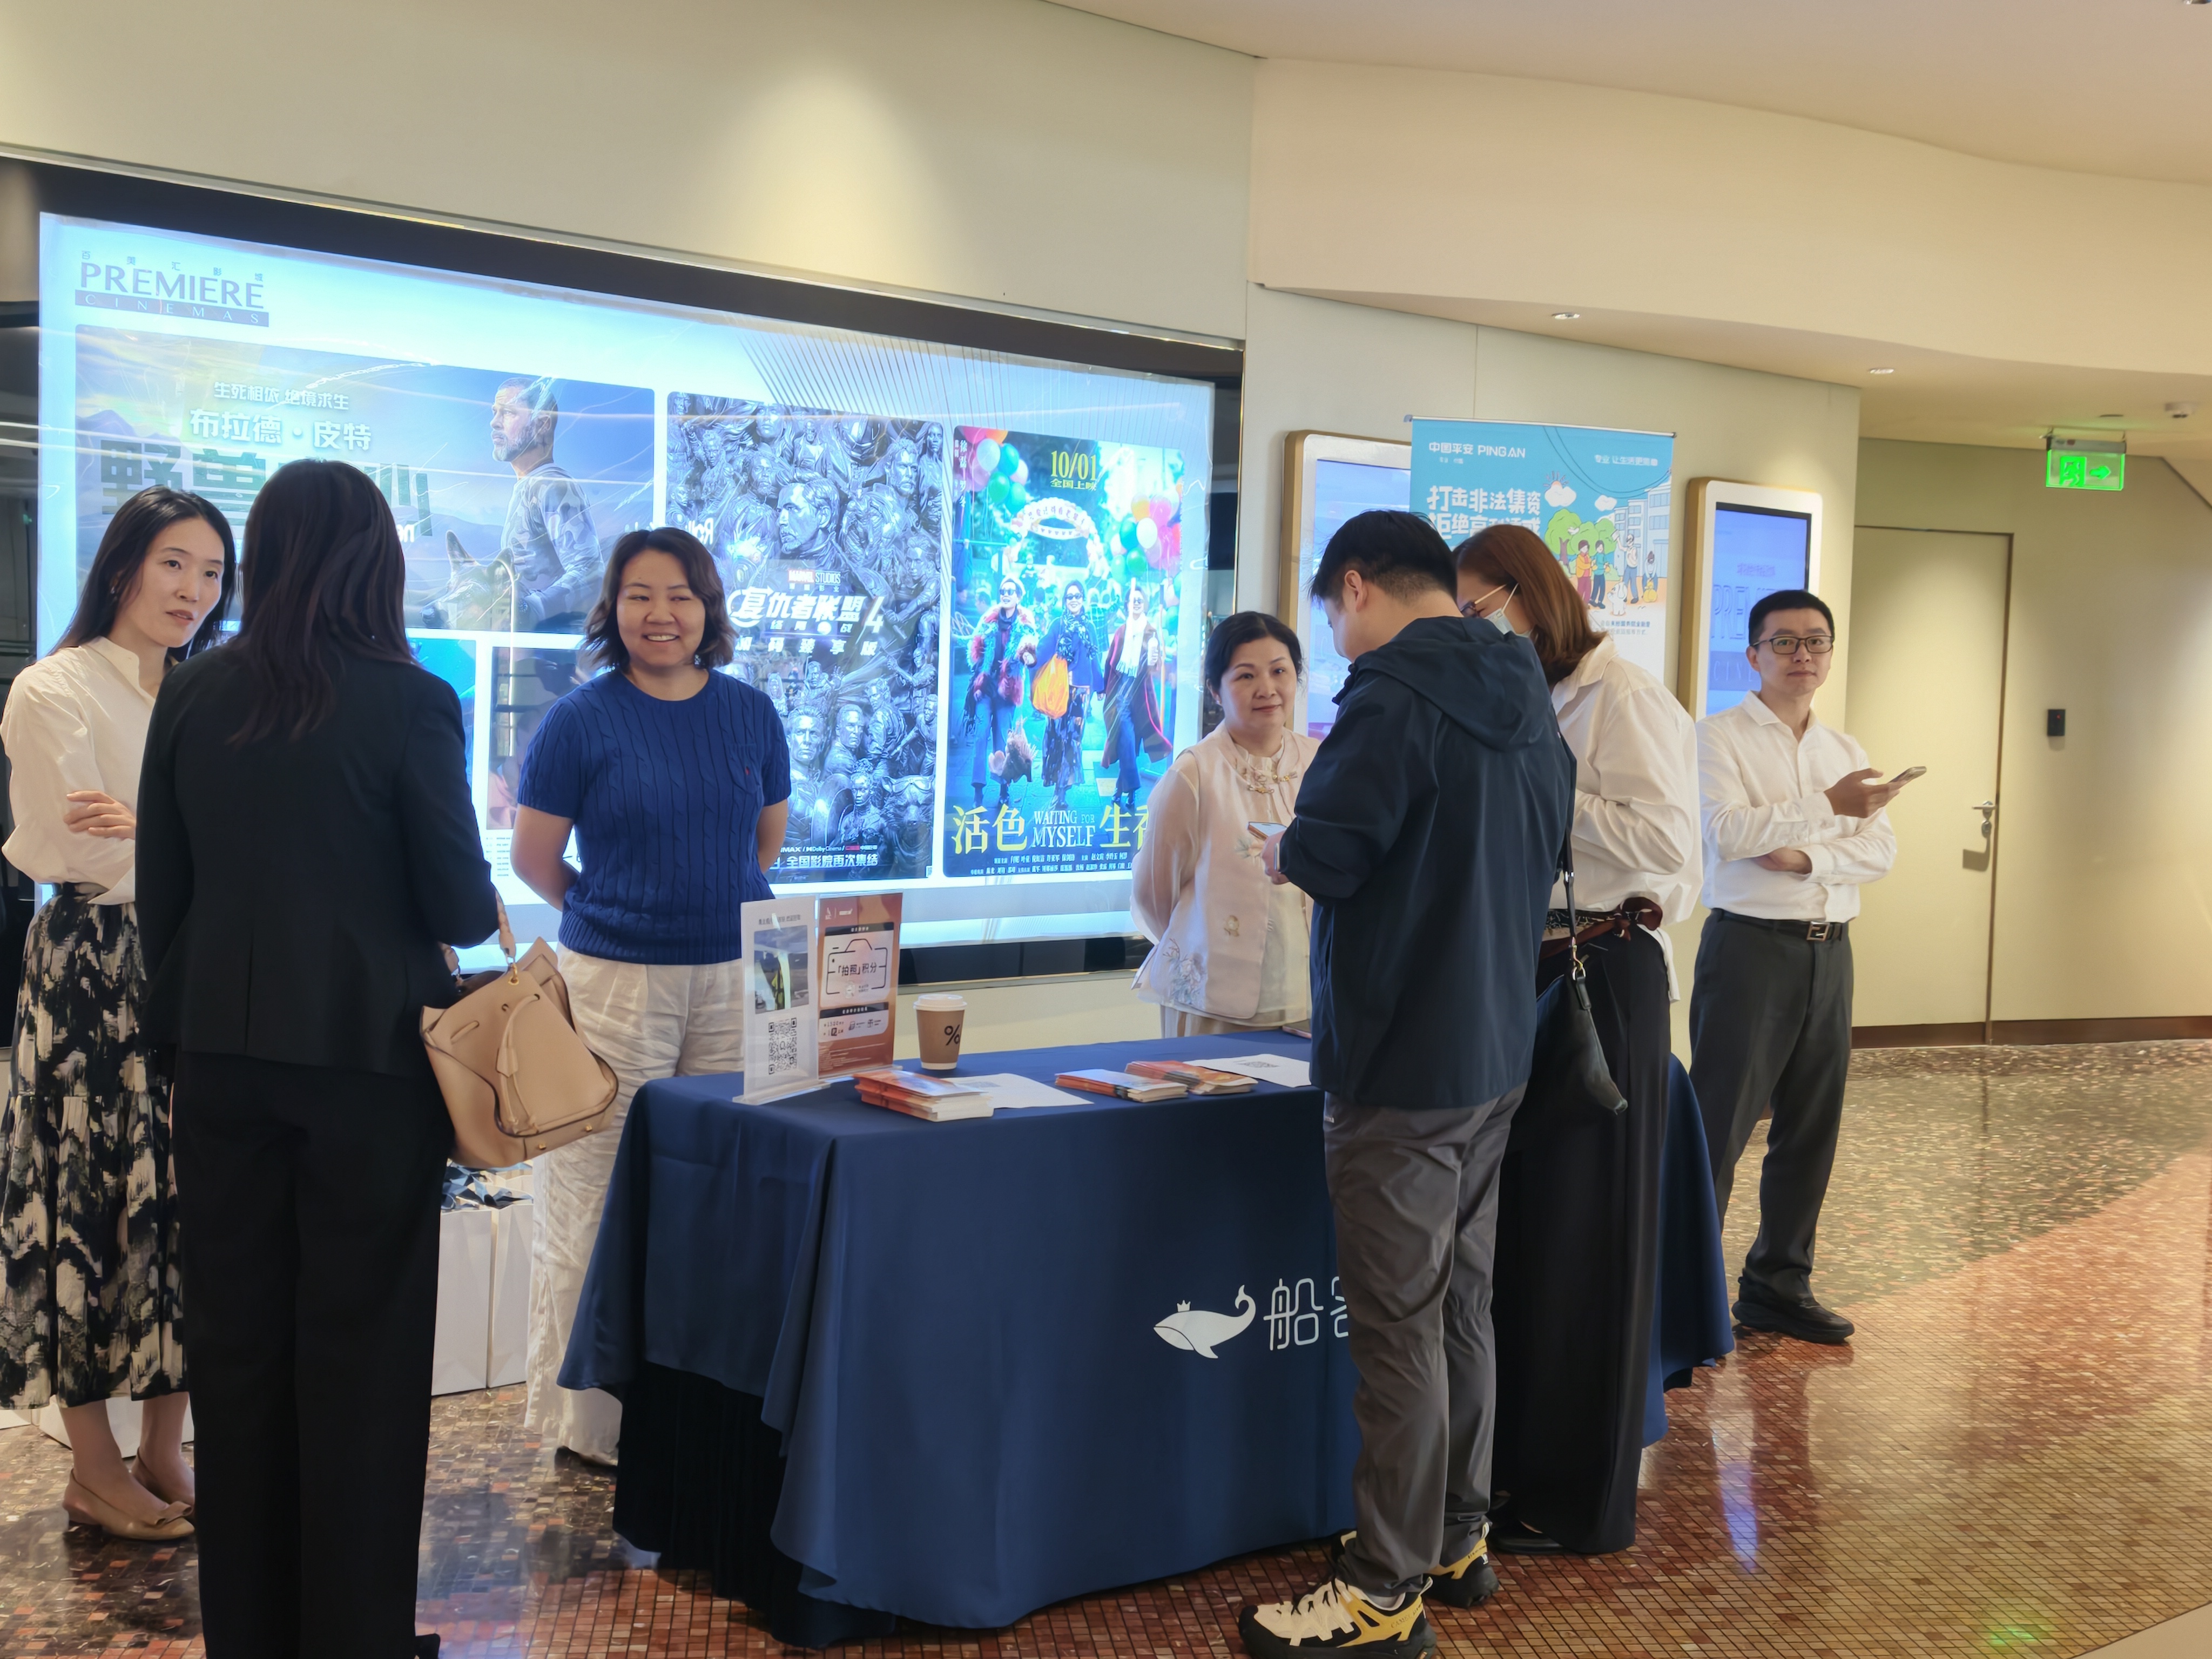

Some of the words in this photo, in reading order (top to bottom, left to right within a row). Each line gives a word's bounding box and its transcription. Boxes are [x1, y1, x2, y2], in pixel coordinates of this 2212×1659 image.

[81, 250, 264, 282] 百美汇影城
[80, 262, 264, 309] PREMIERE
[85, 294, 259, 324] CINEMAS
[214, 381, 281, 403] 生死相依
[285, 389, 349, 410] 绝境求生
[1429, 442, 1474, 455] 中国平安
[1051, 450, 1097, 481] 10/01
[1050, 478, 1097, 491] 全国上映
[1427, 485, 1541, 515] 打击非法集资
[815, 572, 841, 584] STUDIOS
[1034, 810, 1077, 825] WAITING
[1081, 814, 1095, 824] FOR
[1031, 825, 1096, 848] MYSELF
[786, 853, 878, 868] 全国影院再次集结
